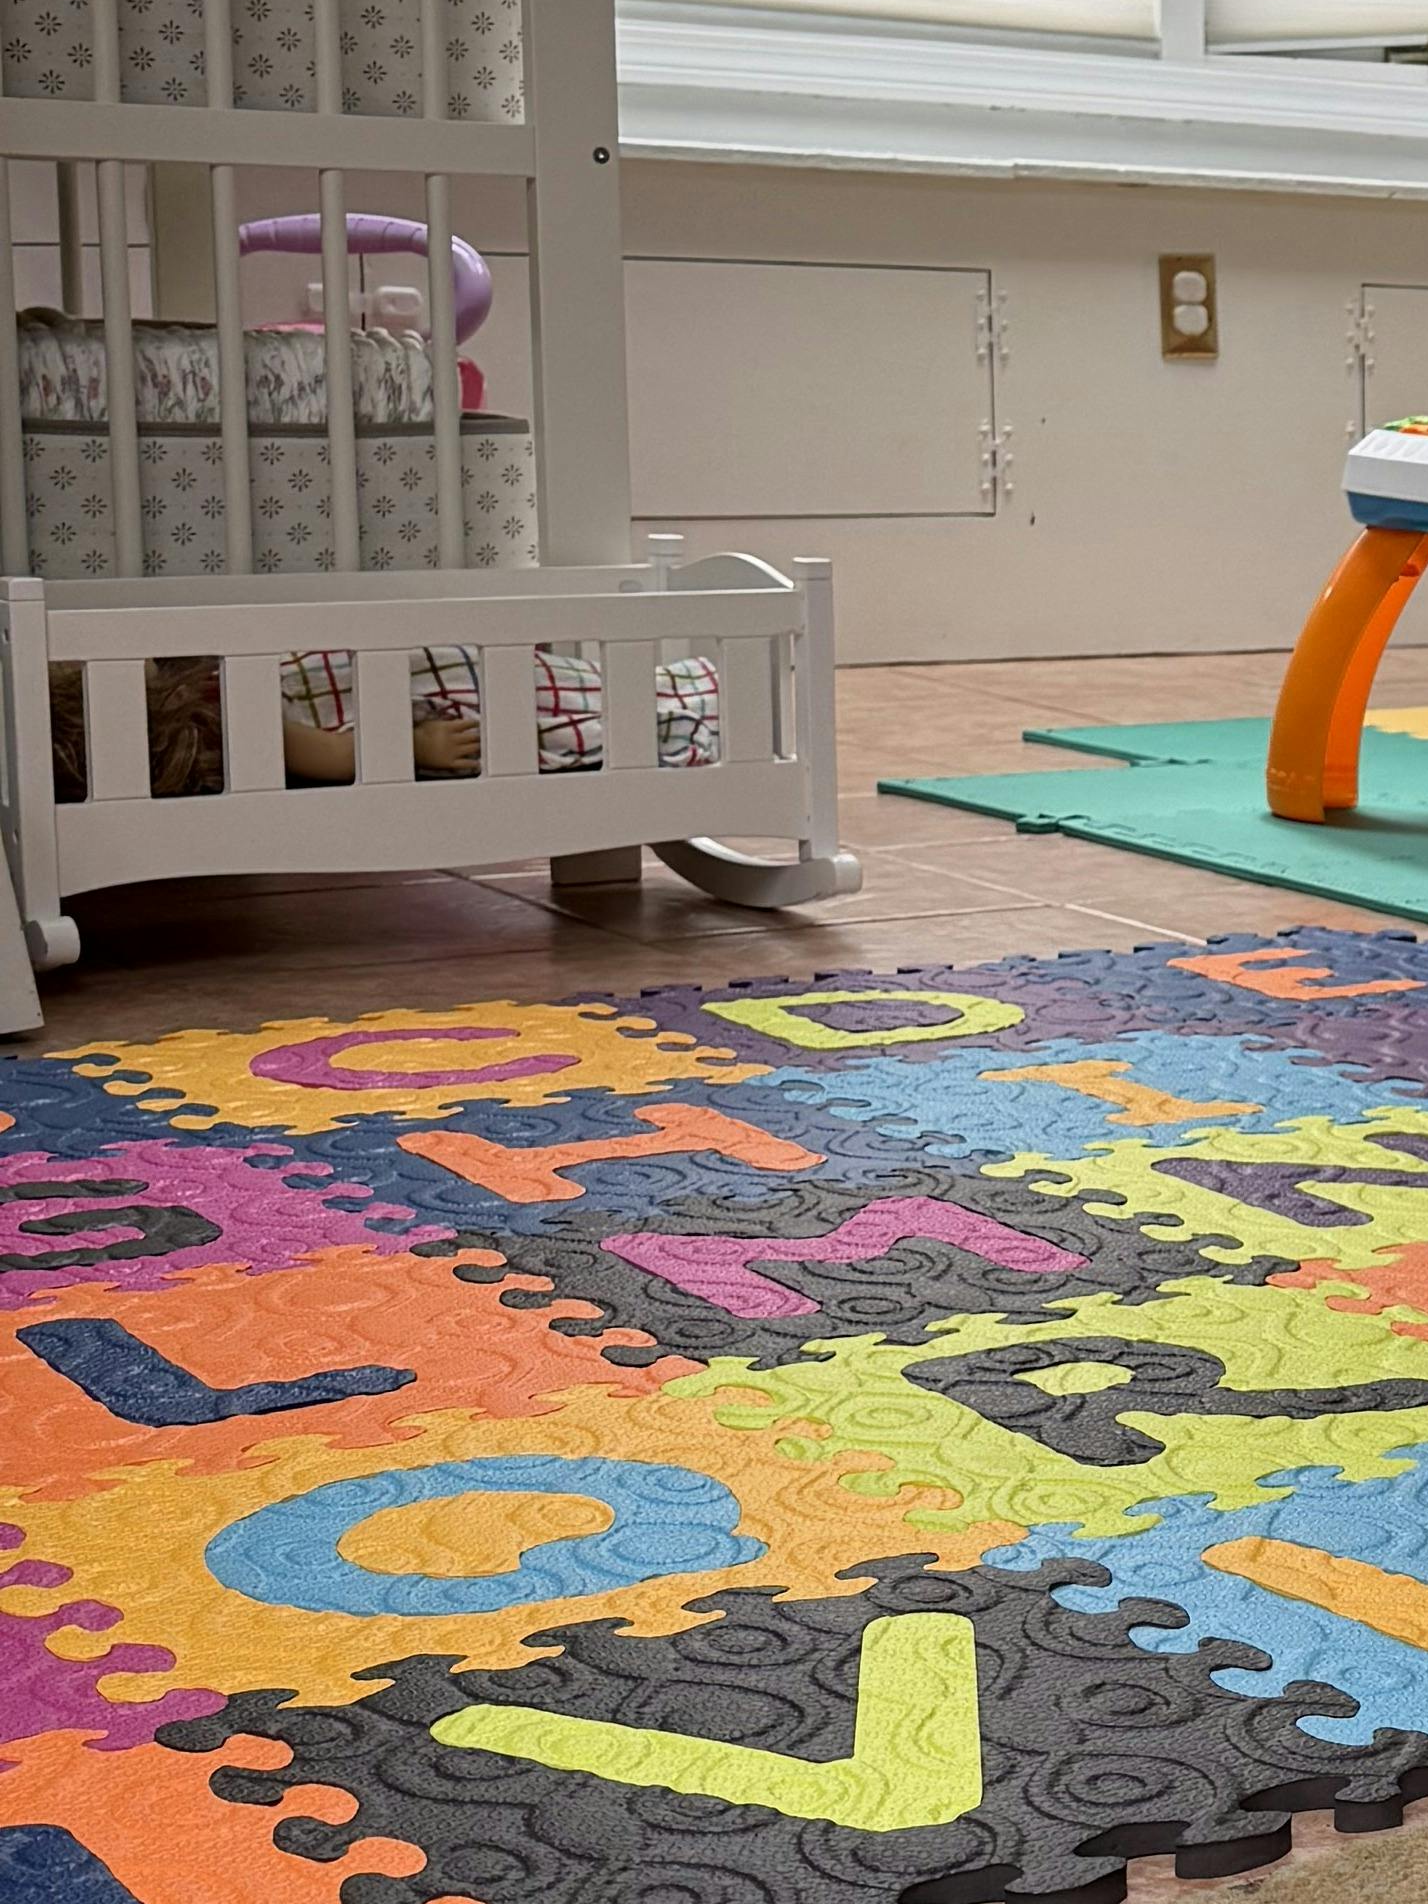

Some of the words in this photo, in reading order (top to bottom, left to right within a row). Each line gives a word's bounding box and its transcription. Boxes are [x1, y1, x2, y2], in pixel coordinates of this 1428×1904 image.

[701, 990, 1026, 1049] D
[1166, 947, 1427, 1002] E
[249, 1027, 582, 1091] C
[977, 1059, 1266, 1127] I
[396, 1103, 828, 1203] H
[600, 1196, 1093, 1319] M
[15, 1318, 418, 1428] L
[204, 1454, 768, 1617] Q
[430, 1611, 983, 1832] V
